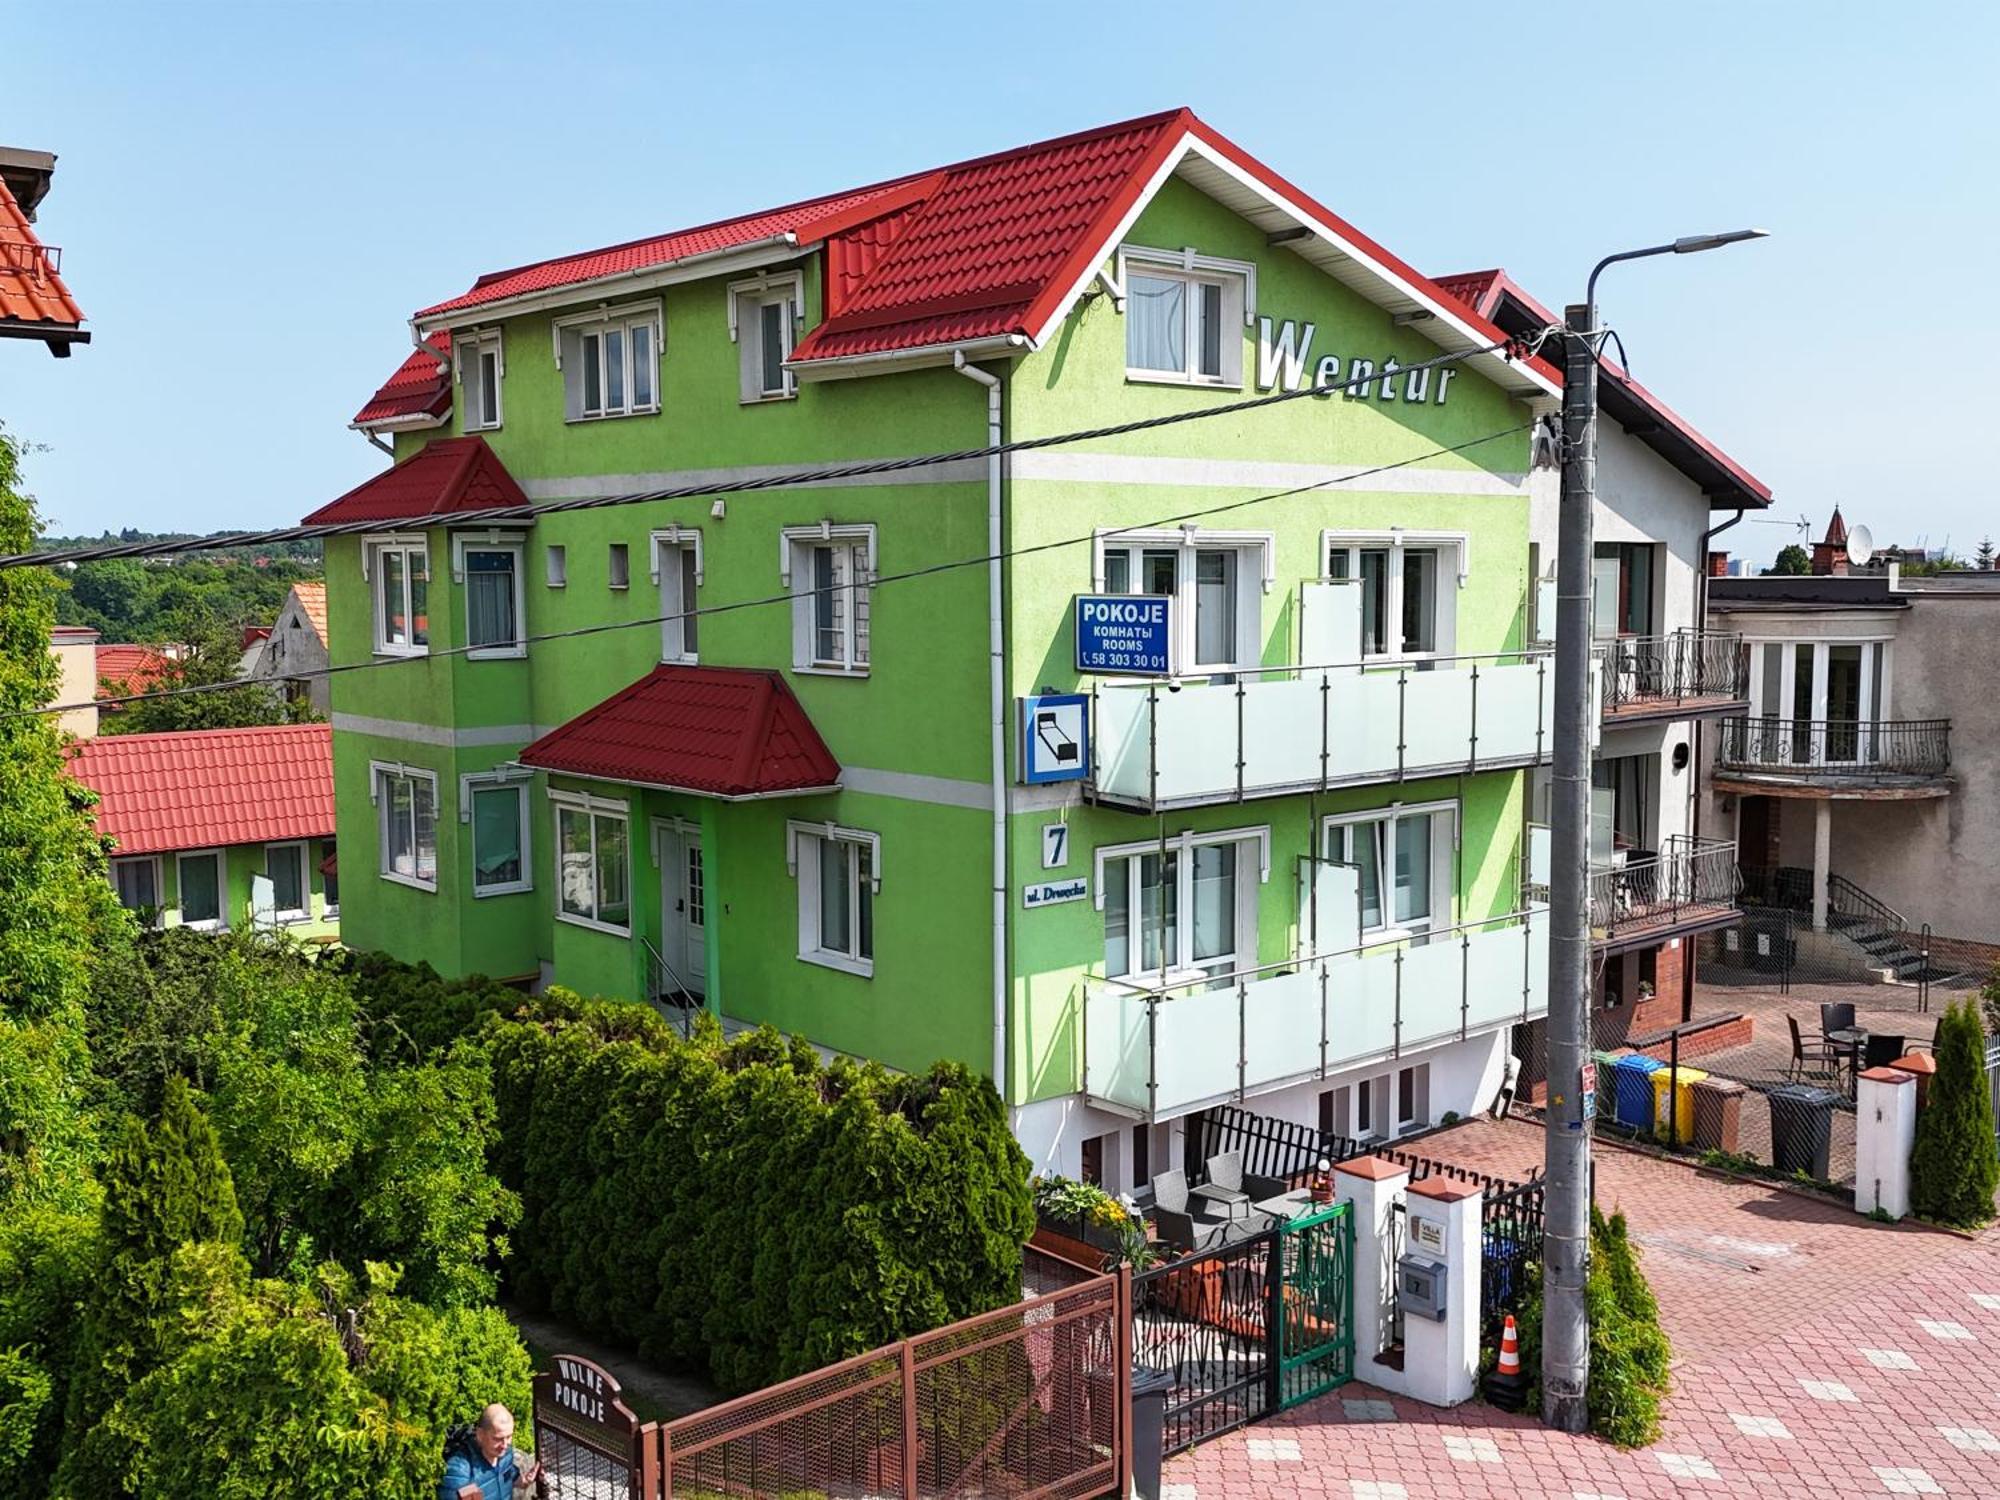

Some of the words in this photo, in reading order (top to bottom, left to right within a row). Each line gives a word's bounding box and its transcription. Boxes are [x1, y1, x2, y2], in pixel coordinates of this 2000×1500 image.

[1258, 317, 1456, 405] Wentur
[1084, 603, 1164, 624] POKOJE
[1093, 625, 1153, 639] КОМНАТЫ
[1102, 639, 1144, 652] ROOMS
[1091, 652, 1106, 665] 58
[1108, 653, 1130, 667] 303
[1133, 655, 1148, 668] 30
[1151, 655, 1165, 669] 01
[1049, 827, 1066, 865] 7
[1027, 888, 1041, 904] ul.
[558, 1359, 603, 1396] WOLNE
[555, 1382, 605, 1423] POKOJE
